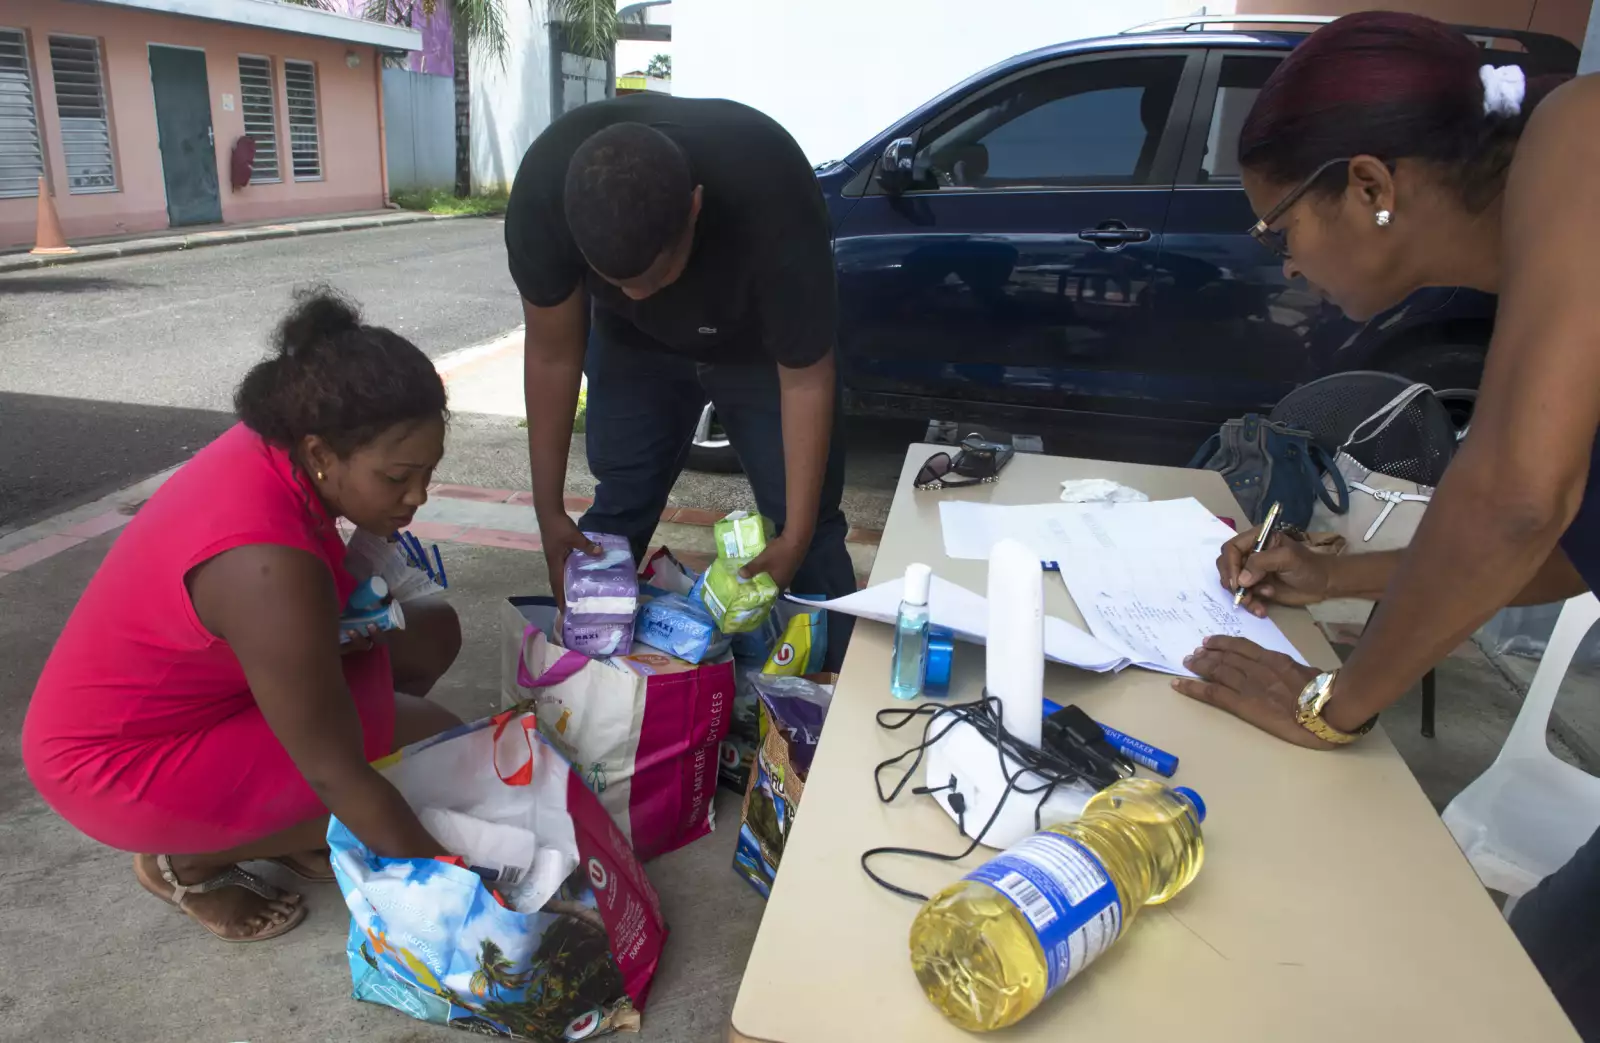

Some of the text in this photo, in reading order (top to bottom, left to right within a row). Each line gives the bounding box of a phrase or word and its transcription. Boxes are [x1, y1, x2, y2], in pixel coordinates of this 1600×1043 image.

[575, 633, 599, 641] MAXI
[706, 691, 723, 748] CYCLÉES
[1123, 736, 1154, 755] MARKER
[592, 864, 603, 883] U
